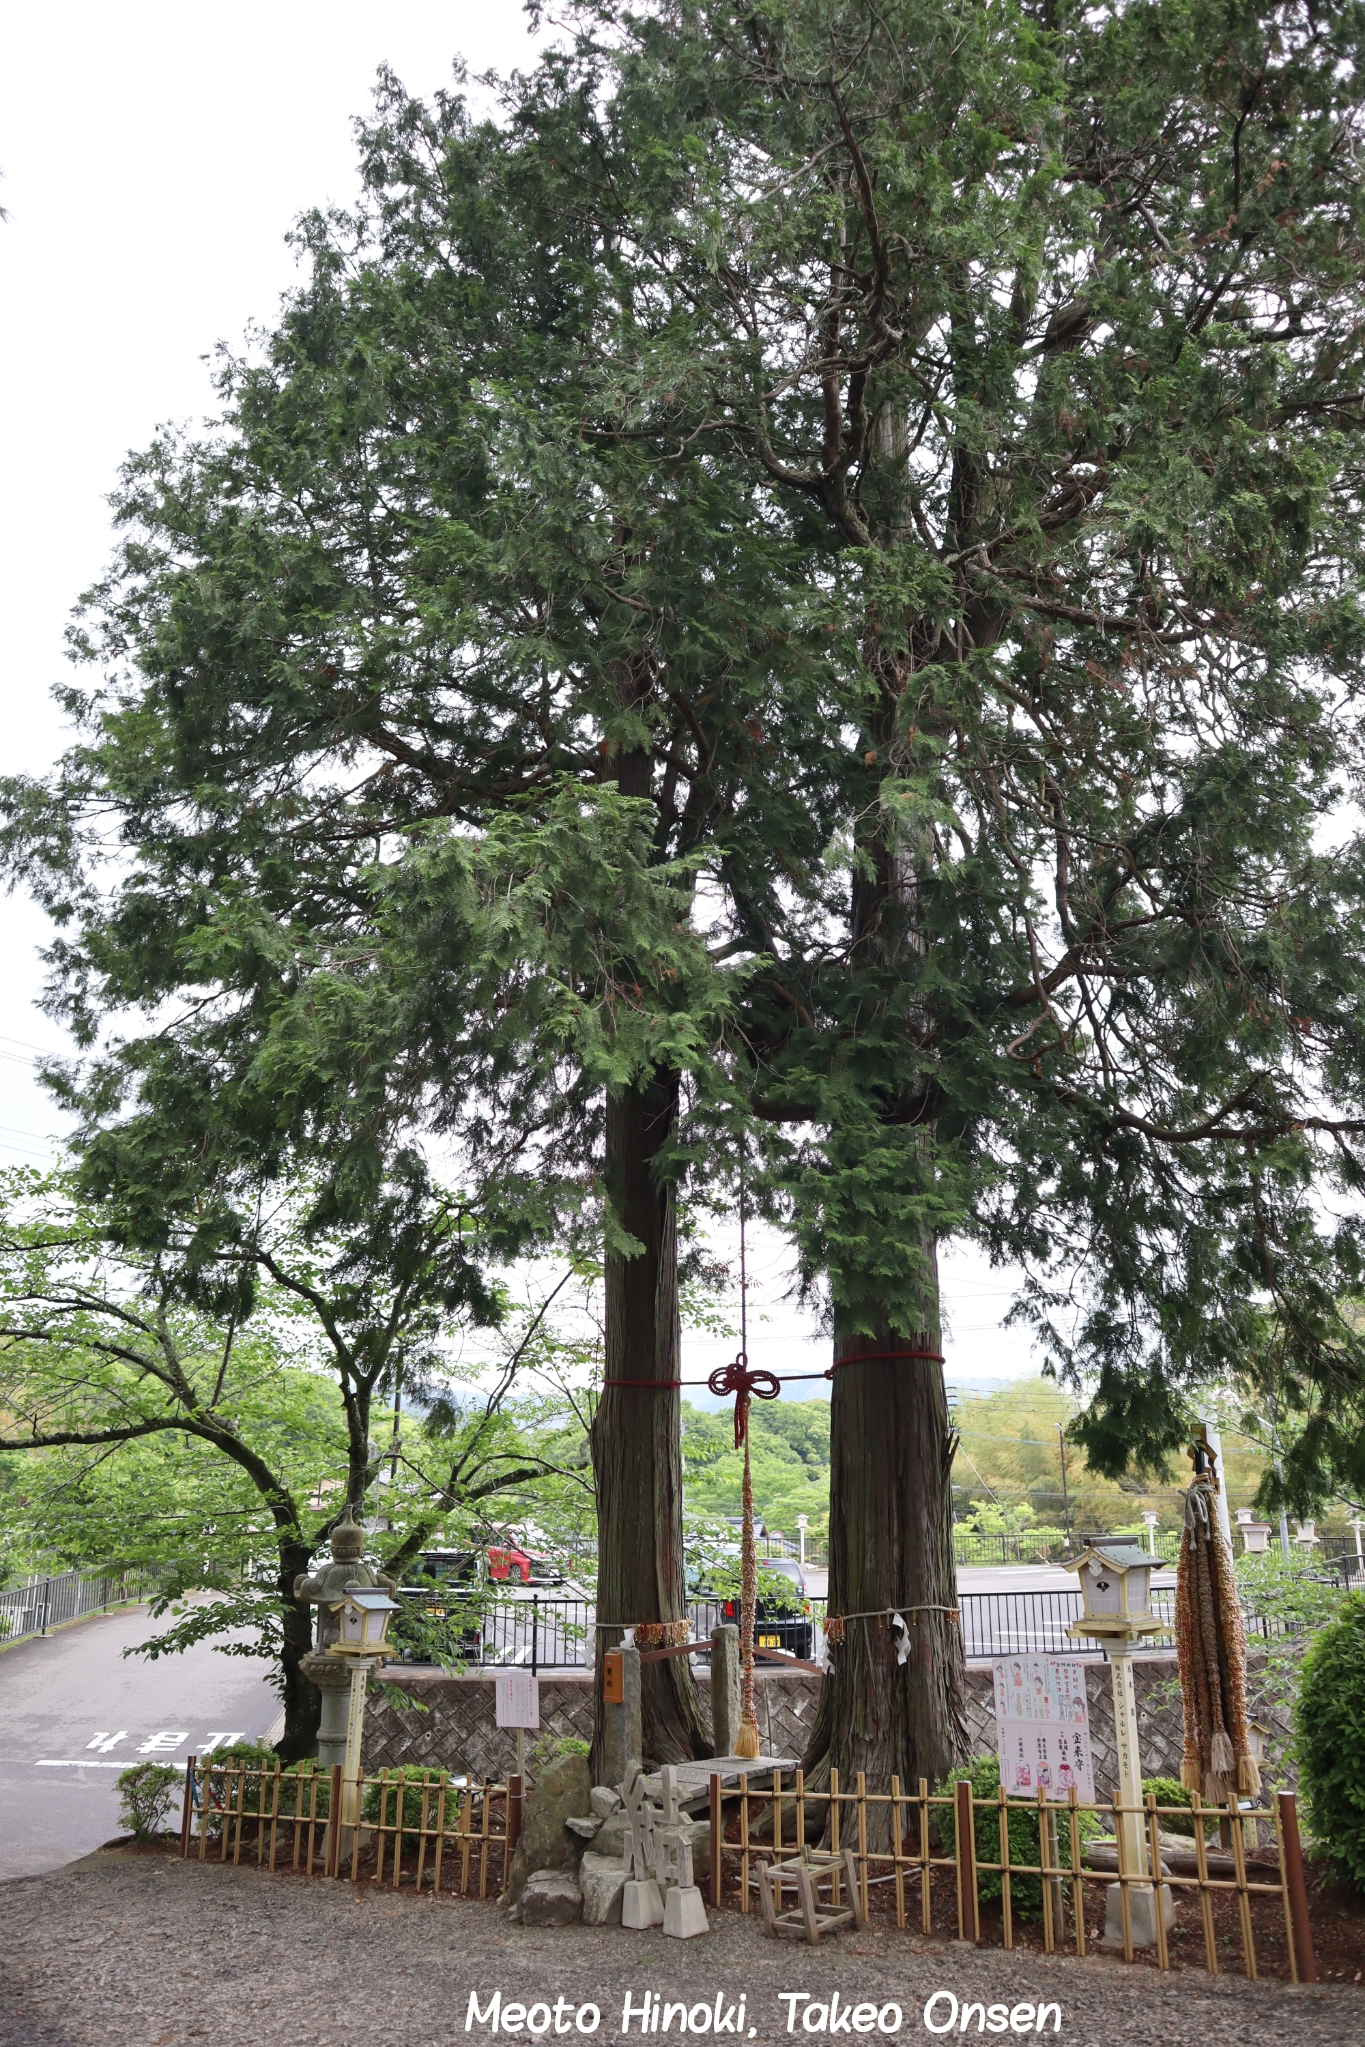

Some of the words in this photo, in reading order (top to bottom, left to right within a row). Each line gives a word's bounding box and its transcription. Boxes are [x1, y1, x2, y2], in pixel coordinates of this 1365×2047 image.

[1115, 1664, 1123, 1697] 株式会社
[1118, 1702, 1127, 1737] シャルレ
[85, 1731, 246, 1755] 止まれ
[1072, 1732, 1084, 1771] 宝来守
[1120, 1742, 1130, 1778] サカモト
